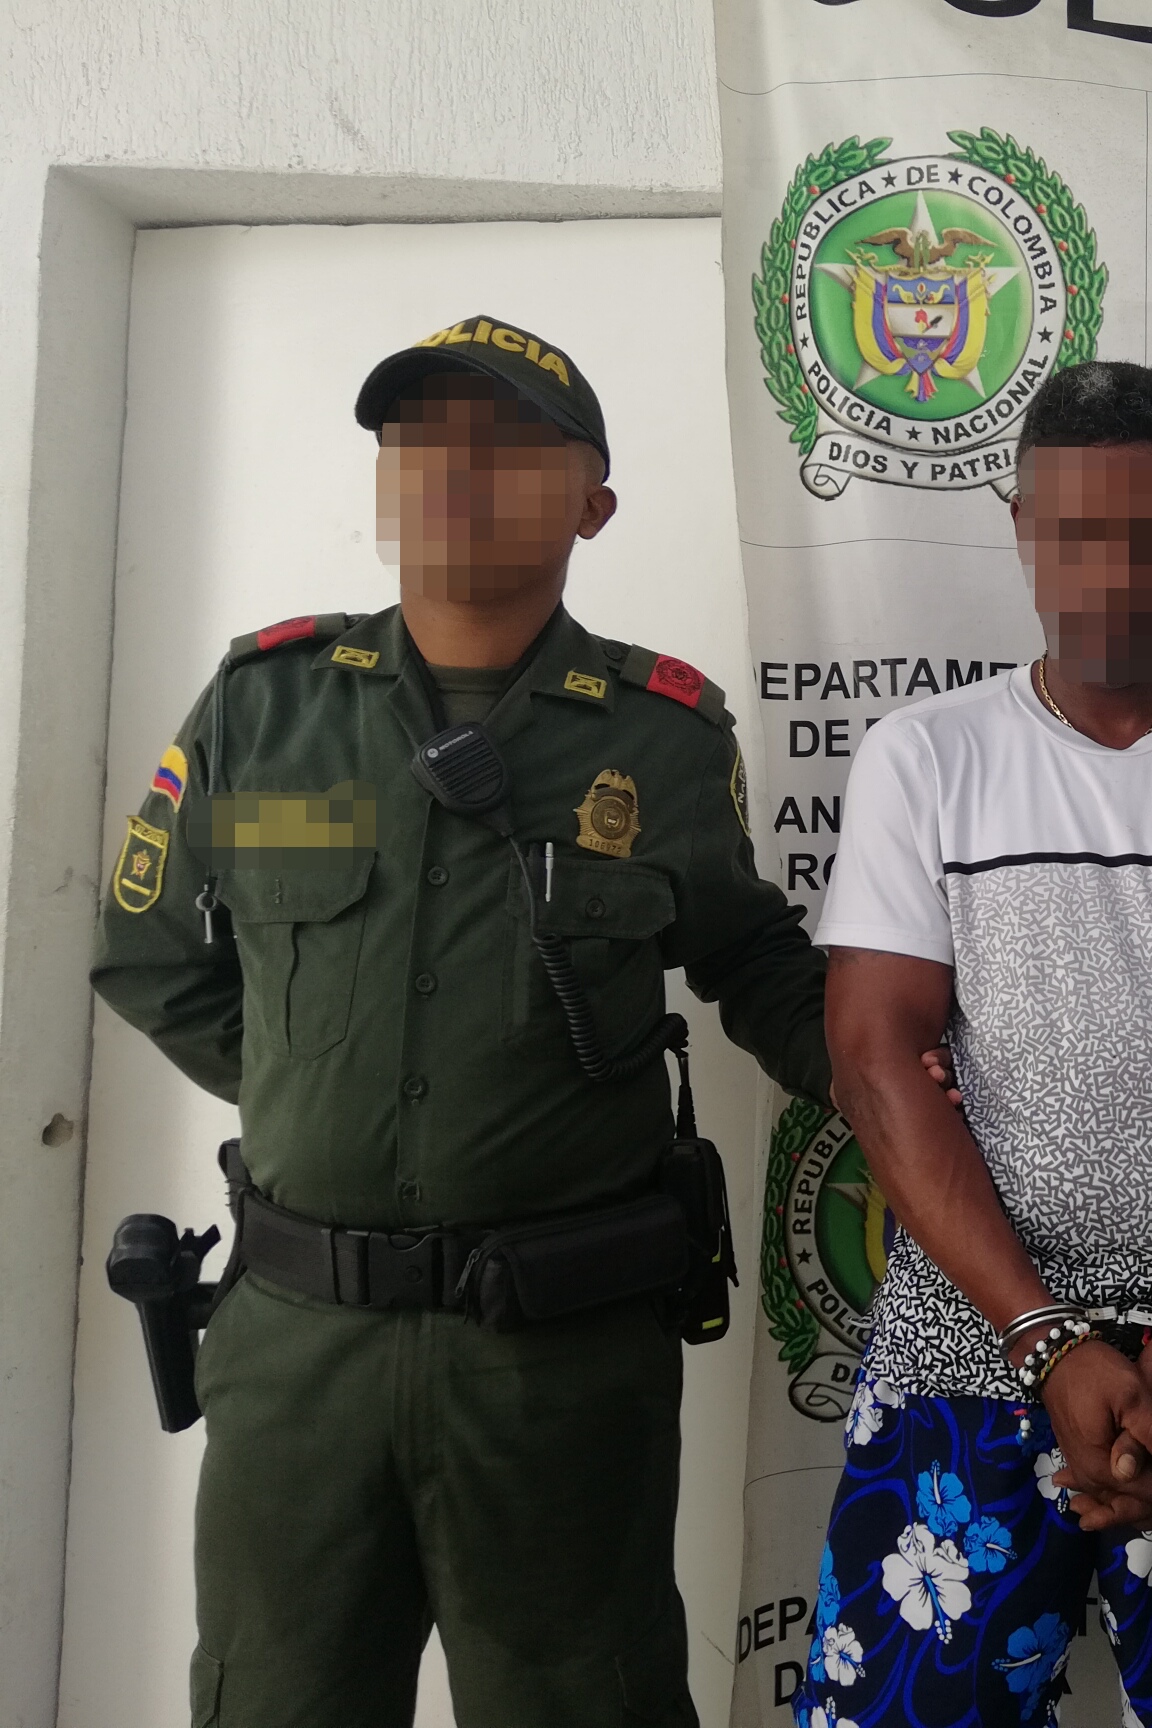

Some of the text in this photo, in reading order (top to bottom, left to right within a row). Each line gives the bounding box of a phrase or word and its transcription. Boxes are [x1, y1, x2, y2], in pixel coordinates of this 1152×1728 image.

[795, 164, 1057, 320] REPUBLICA DE COLOMBIA
[412, 320, 570, 387] OLICIA
[807, 354, 1049, 445] POLICIA NACIONAL
[828, 441, 1017, 482] DIOS Y PATRI
[789, 719, 851, 758] DE
[793, 1116, 852, 1235] REPUBLI
